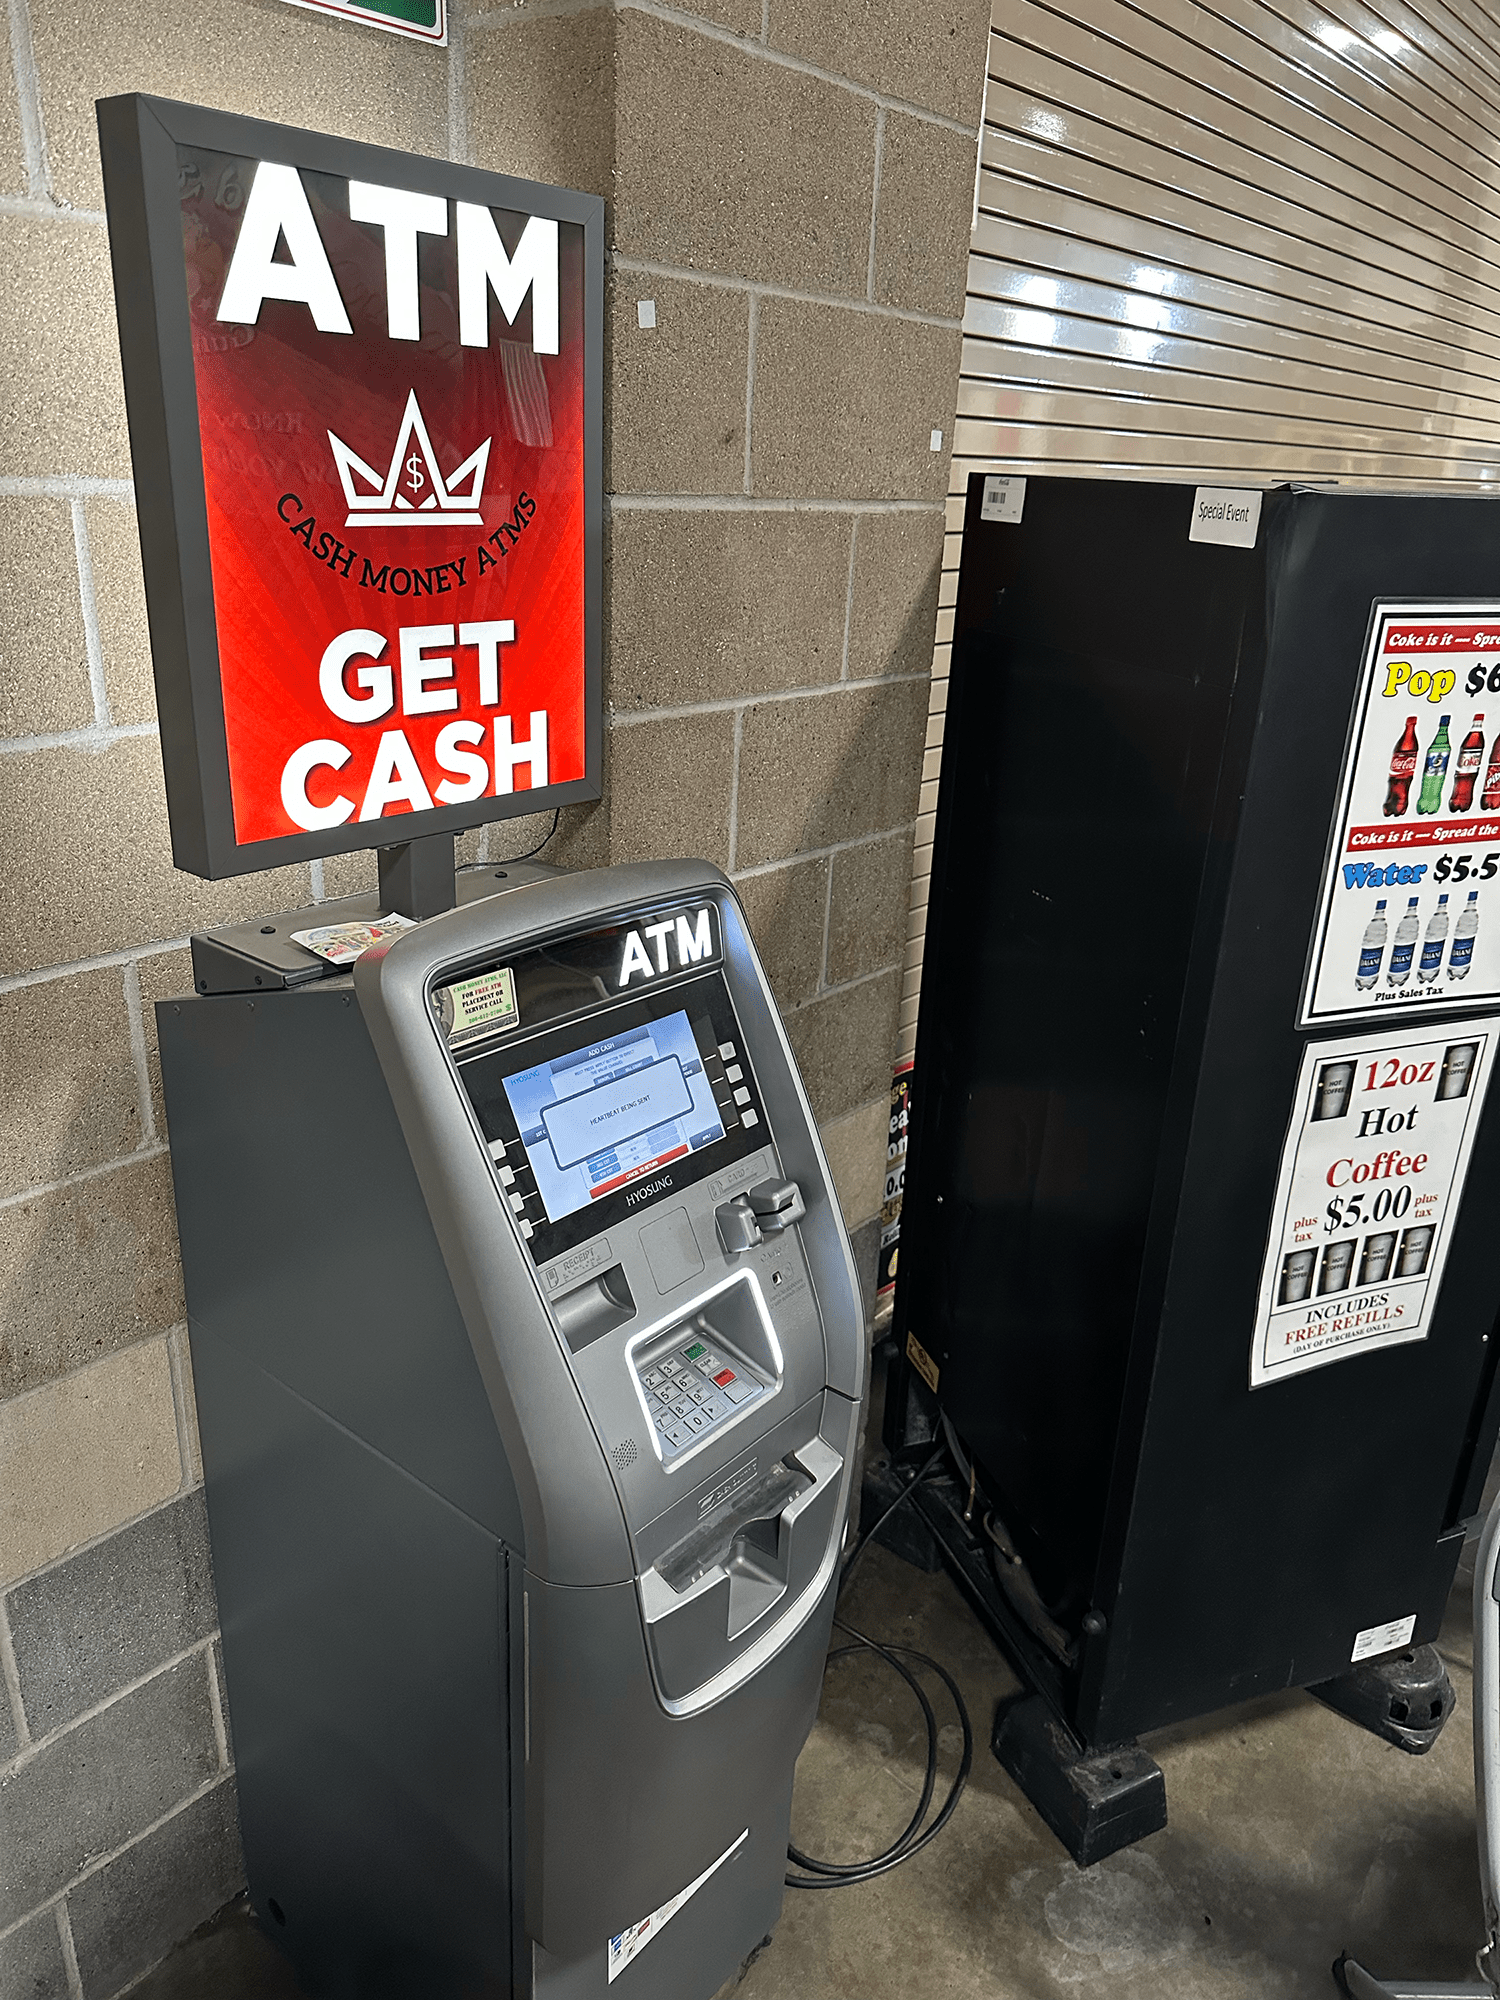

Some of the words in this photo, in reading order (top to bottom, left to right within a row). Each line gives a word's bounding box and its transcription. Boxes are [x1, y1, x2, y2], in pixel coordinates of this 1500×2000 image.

[216, 161, 559, 355] ATM
[1198, 501, 1226, 522] Special
[1226, 503, 1250, 522] Event
[277, 492, 358, 578] CASH
[358, 557, 467, 597] MONEY
[477, 491, 538, 576] ATMS
[1388, 633, 1424, 647] Coke
[1425, 632, 1440, 646] is
[1440, 632, 1454, 646] it
[317, 619, 515, 724] GET
[1381, 661, 1456, 703] Pop
[280, 710, 549, 833] CASH
[1351, 833, 1386, 846] Coke
[1386, 831, 1400, 843] is
[1400, 829, 1414, 842] it
[1432, 825, 1478, 841] Spread
[1478, 823, 1499, 836] the
[1342, 862, 1428, 890] Water
[618, 908, 712, 987] ATM
[461, 991, 474, 999] FOR
[475, 986, 489, 996] FREE
[490, 982, 502, 990] ATM
[462, 992, 495, 1008] PLACEMENT
[495, 989, 504, 997] OR
[1374, 992, 1396, 1001] Plus
[1398, 989, 1423, 999] Sales
[1426, 987, 1444, 995] Tax
[464, 1002, 489, 1015] SERVICE
[489, 997, 503, 1007] CALL
[588, 1046, 600, 1057] ADD
[600, 1042, 615, 1053] CASH
[510, 1069, 540, 1087] HYOSUNG
[1362, 1058, 1436, 1092] 12oz
[590, 1108, 620, 1126] HEARTBEAT
[620, 1100, 637, 1114] BEING
[637, 1094, 651, 1108] SENT
[1355, 1104, 1419, 1138] Hot
[625, 1169, 639, 1180] CANCEL
[1326, 1149, 1428, 1188] Coffee
[625, 1174, 673, 1207] HYOSUNG
[1414, 1193, 1439, 1207] plus
[1324, 1185, 1412, 1235] $5.00
[1414, 1208, 1433, 1218] tax
[1293, 1216, 1318, 1232] plus
[1294, 1232, 1313, 1243] tax
[562, 1247, 595, 1271] RECEIPT
[1305, 1293, 1389, 1324] INCLUDES
[1284, 1322, 1328, 1346] FREE
[1331, 1304, 1404, 1332] REFILLS
[1293, 1342, 1312, 1354] (DAY
[1313, 1338, 1324, 1347] OF
[1325, 1328, 1365, 1345] PURCHASE
[1366, 1323, 1391, 1334] ONLY)
[663, 1365, 672, 1374] 3
[700, 1359, 712, 1368] CLEAR
[645, 1377, 654, 1386] 2
[679, 1378, 687, 1387] 6
[660, 1390, 670, 1400] 5
[693, 1393, 702, 1401] 9
[675, 1406, 684, 1414] 8
[656, 1419, 665, 1428] 7
[692, 1416, 702, 1426] 0
